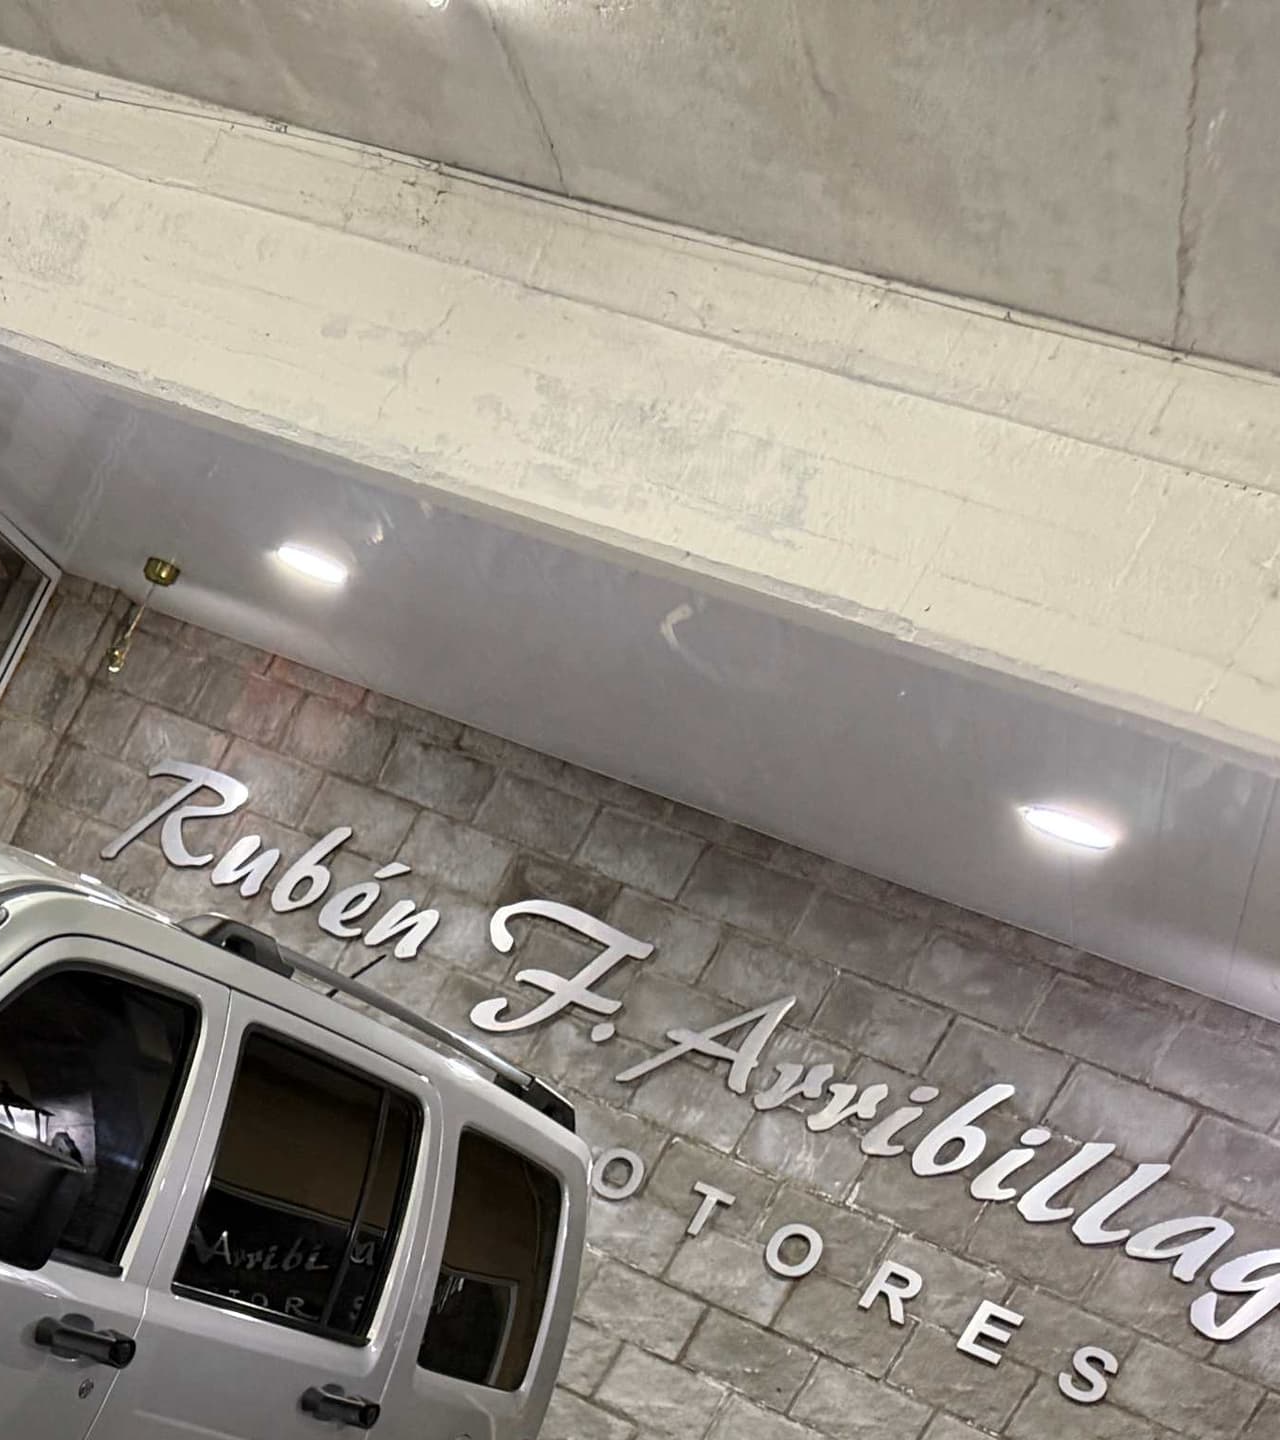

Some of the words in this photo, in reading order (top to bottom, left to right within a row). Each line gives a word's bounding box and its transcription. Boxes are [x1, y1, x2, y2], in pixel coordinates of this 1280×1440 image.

[99, 757, 440, 961] Rubén
[469, 898, 655, 1043] F.
[591, 1147, 1120, 1404] OTORES
